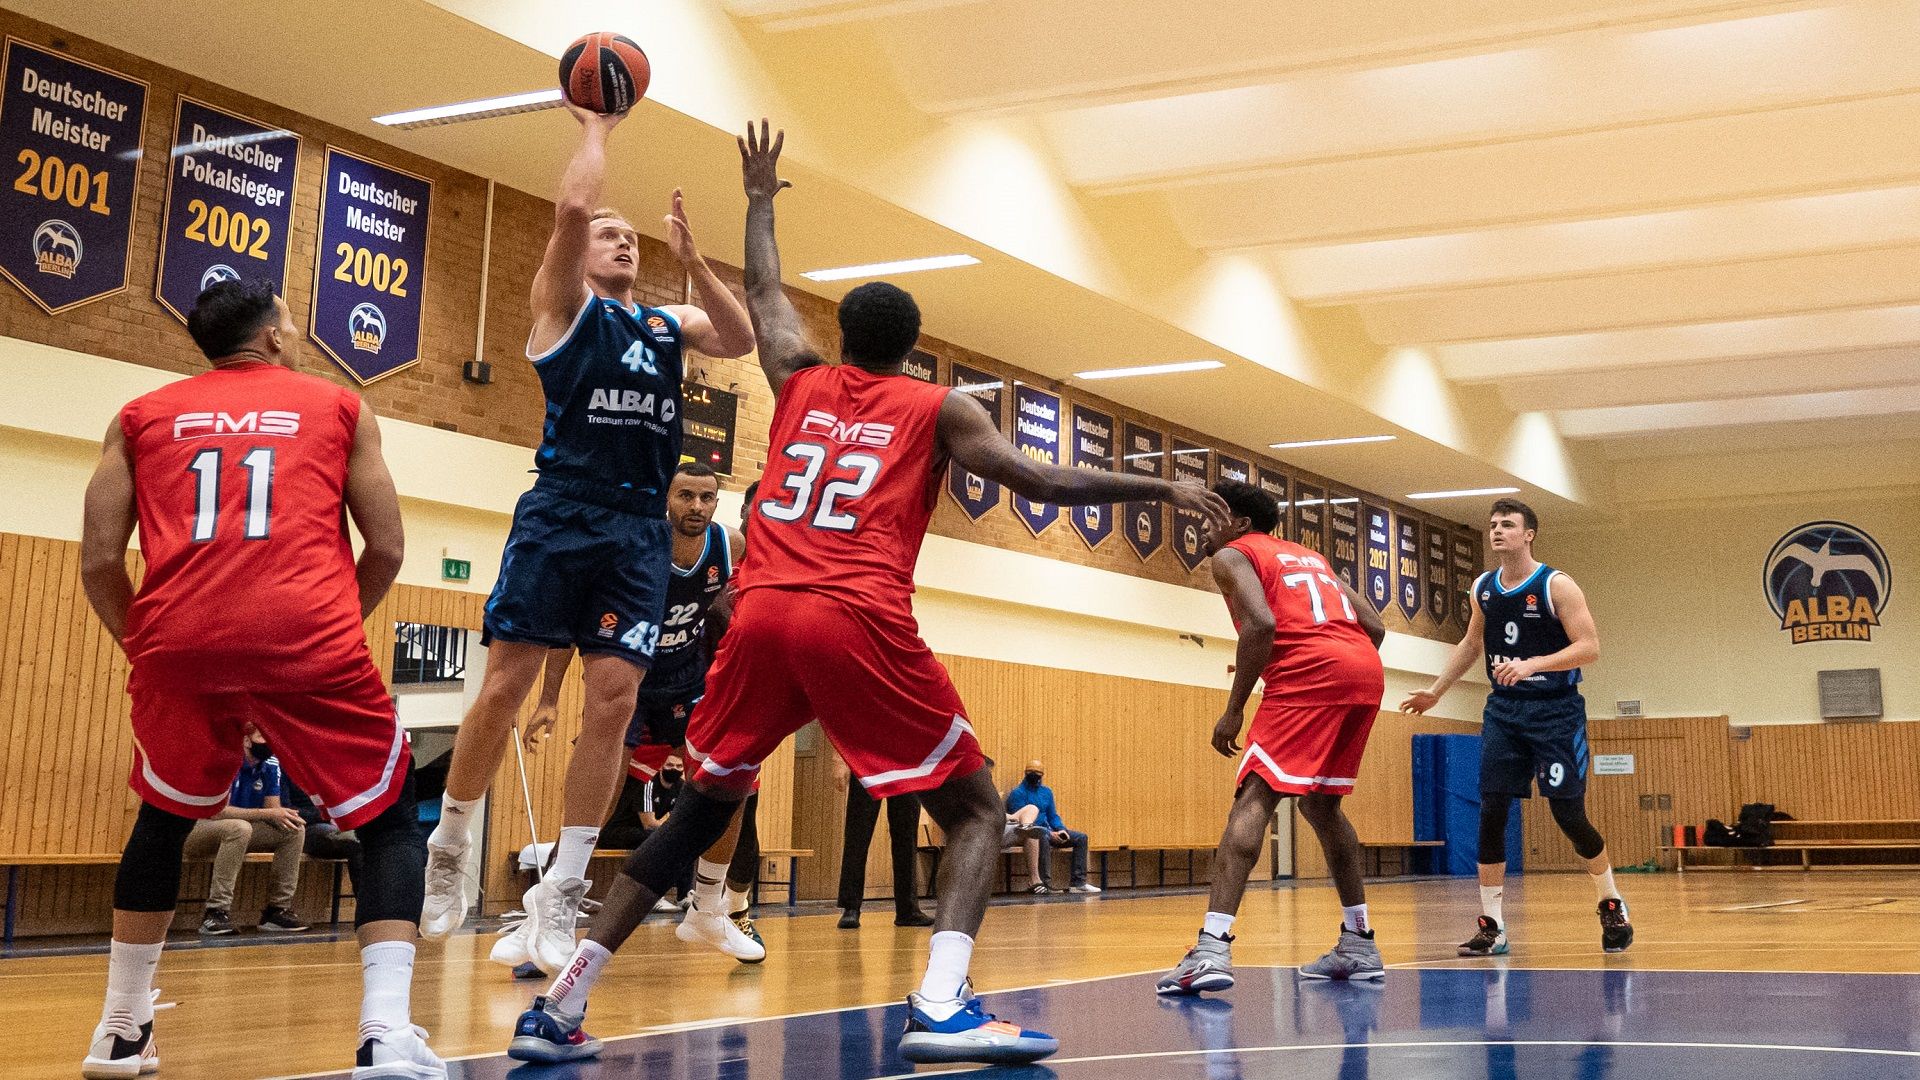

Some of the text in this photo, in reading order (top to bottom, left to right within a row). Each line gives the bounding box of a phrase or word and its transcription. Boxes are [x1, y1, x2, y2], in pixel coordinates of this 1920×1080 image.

[22, 67, 128, 122] Deutscher
[32, 107, 111, 153] Meister
[192, 123, 283, 173] Deutscher
[14, 148, 111, 216] 2001
[182, 155, 285, 207] Pokalsieger
[338, 171, 418, 216] Deutscher
[185, 199, 271, 261] 2002
[346, 205, 406, 243] Meister
[40, 250, 73, 271] ALBA
[334, 242, 409, 298] 2002
[355, 330, 379, 346] ALBA
[587, 388, 655, 417] ALBA
[1020, 397, 1056, 421] Deutscher
[174, 409, 301, 440] FMS
[800, 409, 896, 447] FMS
[1017, 417, 1058, 444] Pokalsieger
[1076, 415, 1109, 439] Deutscher
[1080, 437, 1106, 458] Meister
[187, 447, 276, 543] 11
[760, 442, 883, 531] 32
[1369, 547, 1388, 571] 2017
[1281, 571, 1356, 624] 77
[1783, 595, 1878, 629] ALBA
[619, 620, 660, 657] 43
[656, 629, 688, 647] BA
[1504, 621, 1519, 645] 9
[1793, 623, 1869, 643] BERLIN
[1548, 762, 1565, 787] 9
[564, 956, 588, 988] GSA
